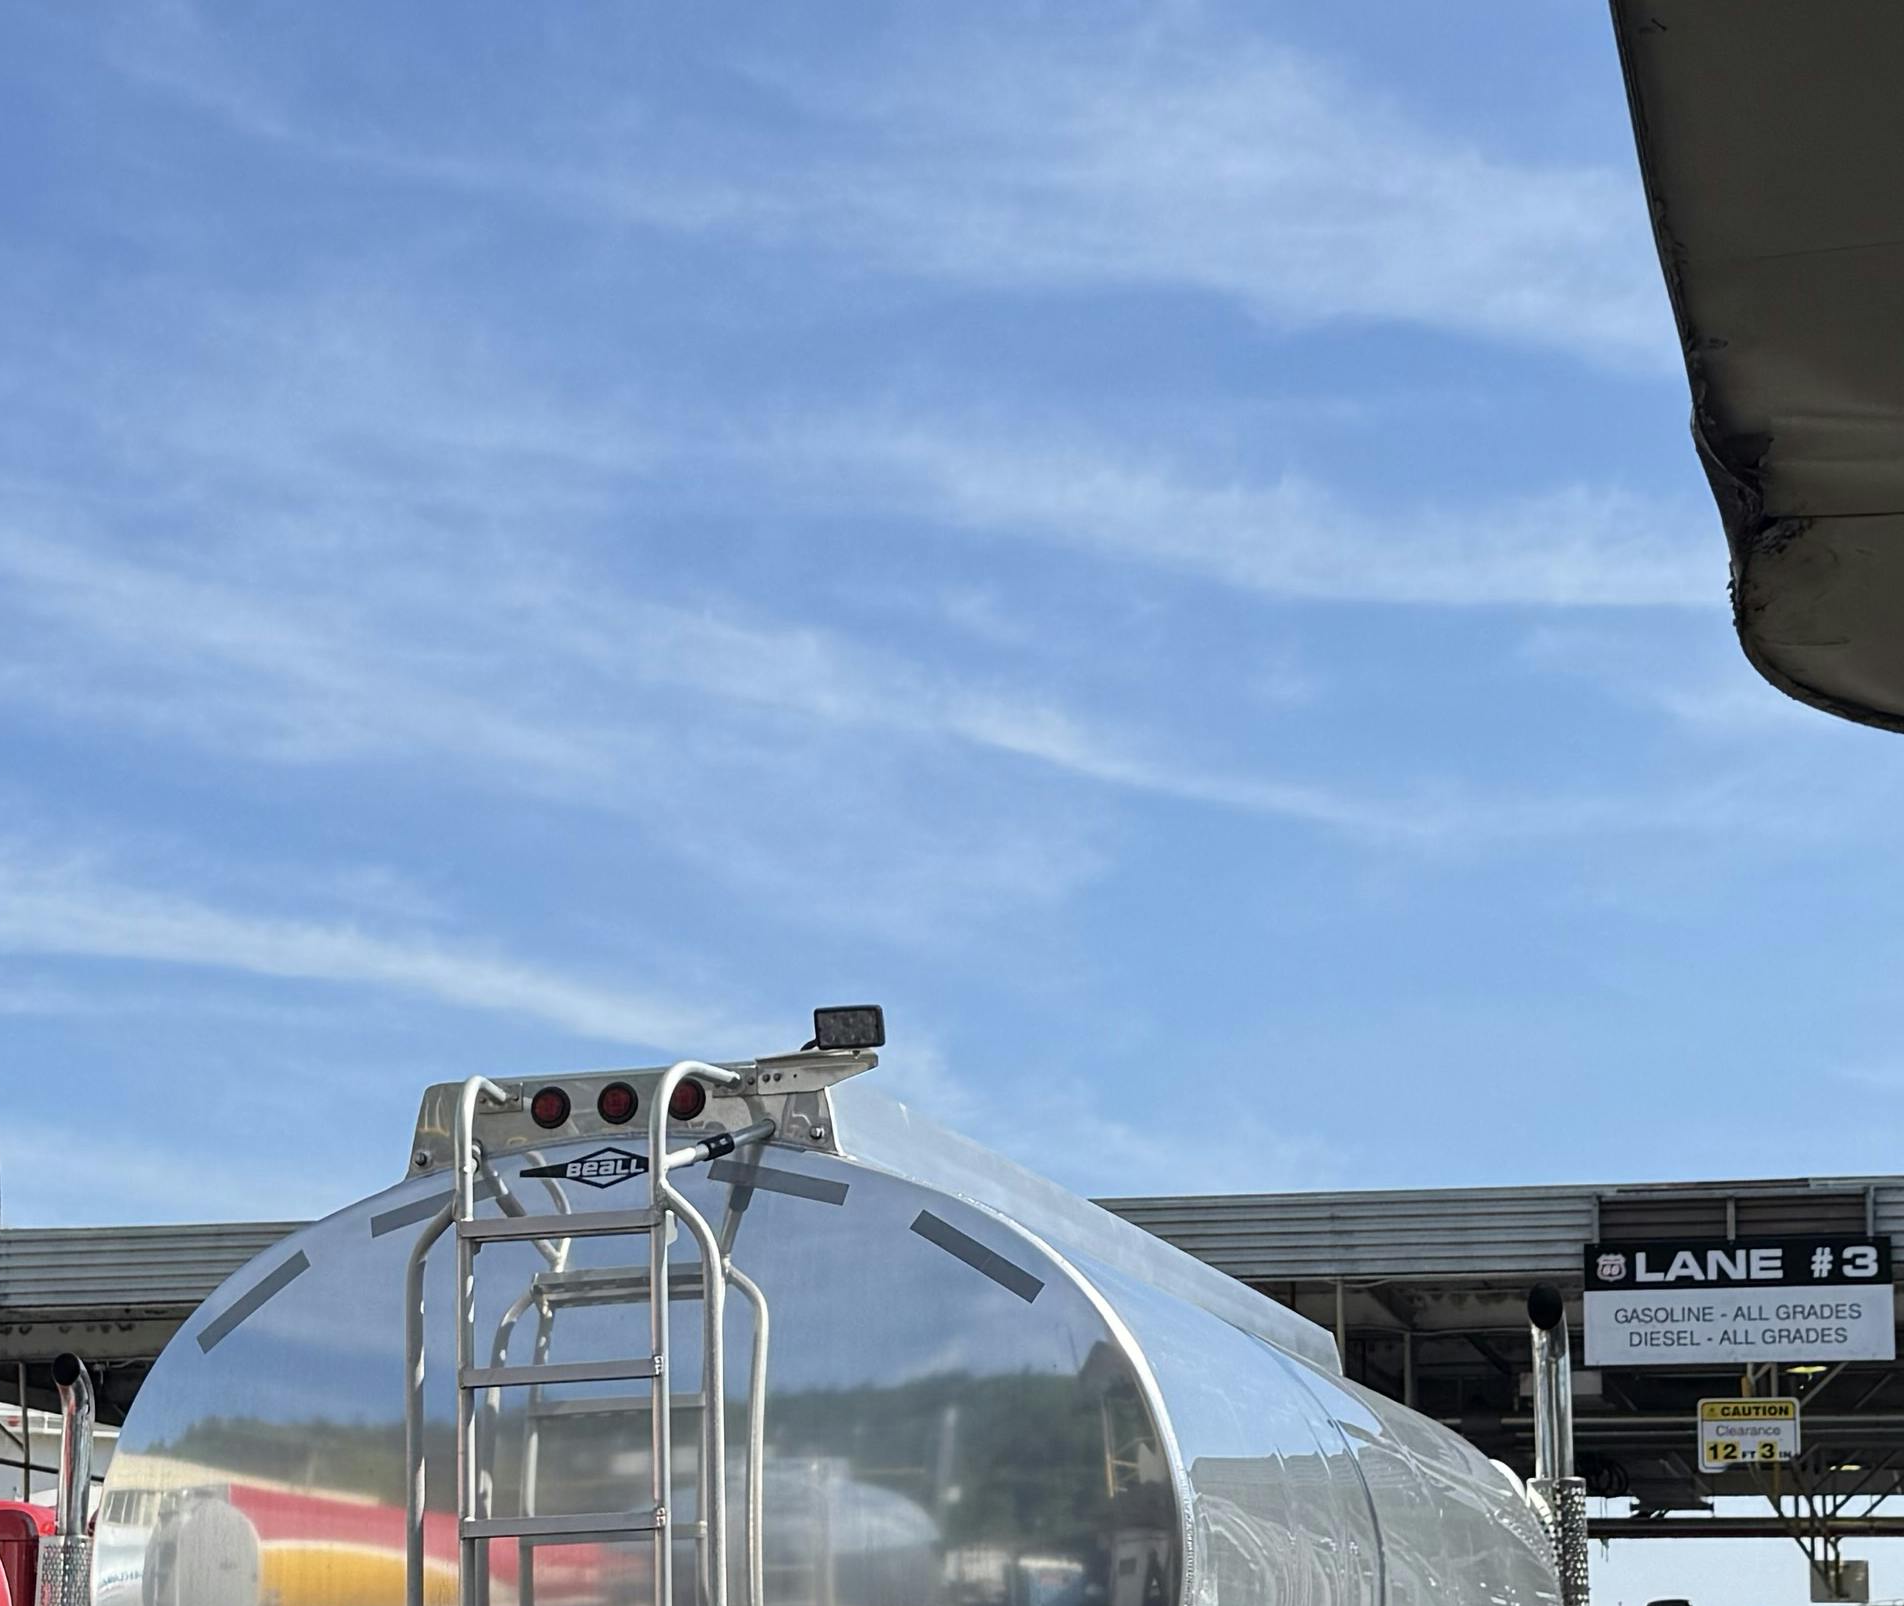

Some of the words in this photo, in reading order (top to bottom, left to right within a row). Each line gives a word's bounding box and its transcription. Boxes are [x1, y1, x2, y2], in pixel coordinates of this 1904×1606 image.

[1635, 1248, 1783, 1282] LANE
[1614, 1306, 1714, 1324] GASOLINE
[1732, 1305, 1770, 1322] ALL
[1775, 1303, 1863, 1321] GRADES
[1629, 1330, 1700, 1348] DIESEL
[1718, 1329, 1756, 1346] ALL
[1761, 1327, 1848, 1345] GRADES
[1720, 1405, 1789, 1417] CAUTION
[1716, 1425, 1782, 1437] Clearance
[1708, 1443, 1737, 1460] 12
[1742, 1451, 1755, 1459] FT
[1761, 1443, 1775, 1459] 3
